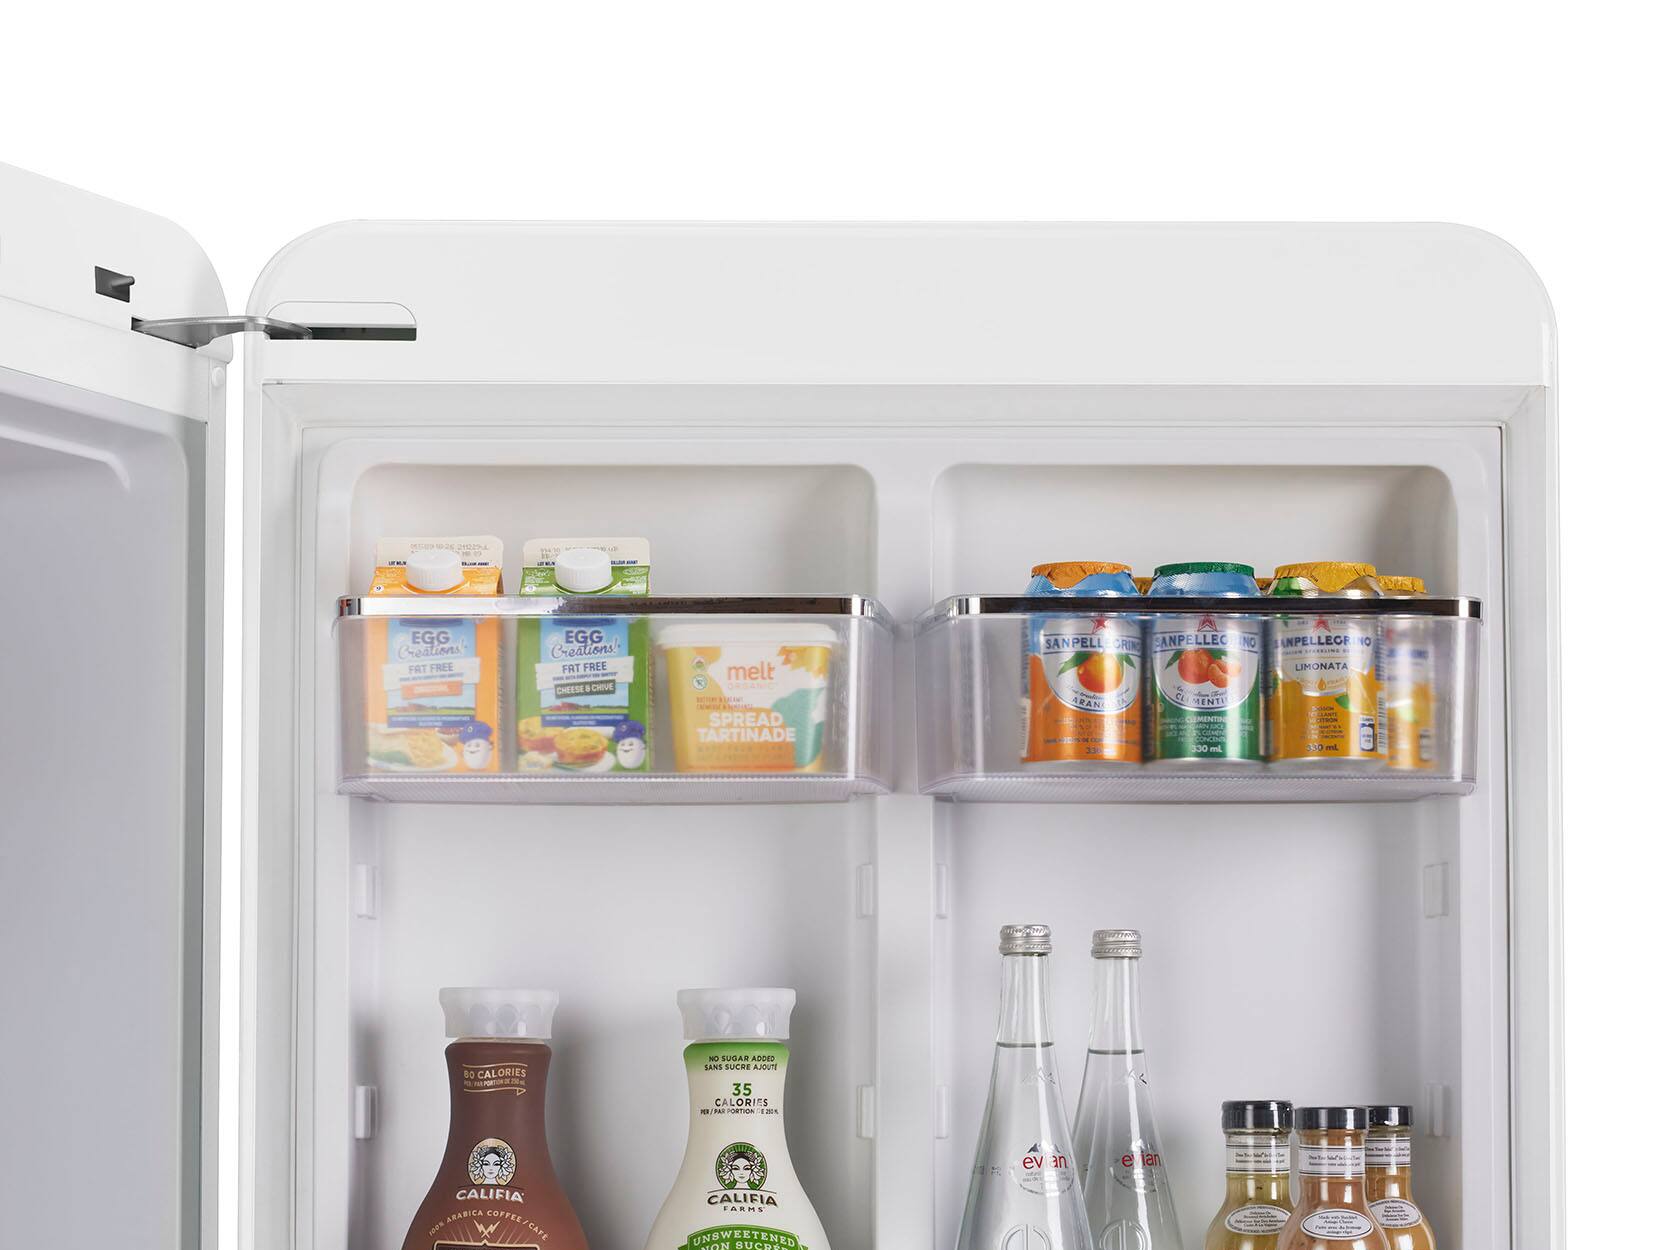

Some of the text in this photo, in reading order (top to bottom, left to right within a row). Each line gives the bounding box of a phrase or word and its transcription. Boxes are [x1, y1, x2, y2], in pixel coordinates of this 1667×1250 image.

[411, 630, 451, 645] EGG
[564, 629, 604, 645] EGG
[1154, 634, 1256, 649] SANPELLEGINO
[1275, 635, 1372, 648] ANPELLEGNO
[408, 662, 454, 674] FAT FREE
[562, 661, 607, 674] FAT FREE
[727, 661, 776, 681] melt
[1295, 662, 1348, 671] LIMONATA
[556, 686, 584, 695] CHEESE
[591, 682, 614, 692] CHIVE
[709, 712, 784, 727] SPREAD
[696, 727, 797, 742] TARTINADE
[1306, 744, 1324, 752] 330
[477, 1068, 527, 1079] CALORIES
[725, 1063, 751, 1071] SUCRE
[732, 1082, 752, 1096] 35
[714, 1098, 768, 1107] CALORIES
[1022, 1152, 1069, 1170] evan
[455, 1188, 525, 1203] CALIFIA
[707, 1192, 778, 1207] CALIFIA
[429, 1221, 445, 1237] 100%
[446, 1209, 484, 1224] ARABICA
[486, 1209, 522, 1223] COFFEE
[693, 1229, 796, 1248] UNSWEETENED
